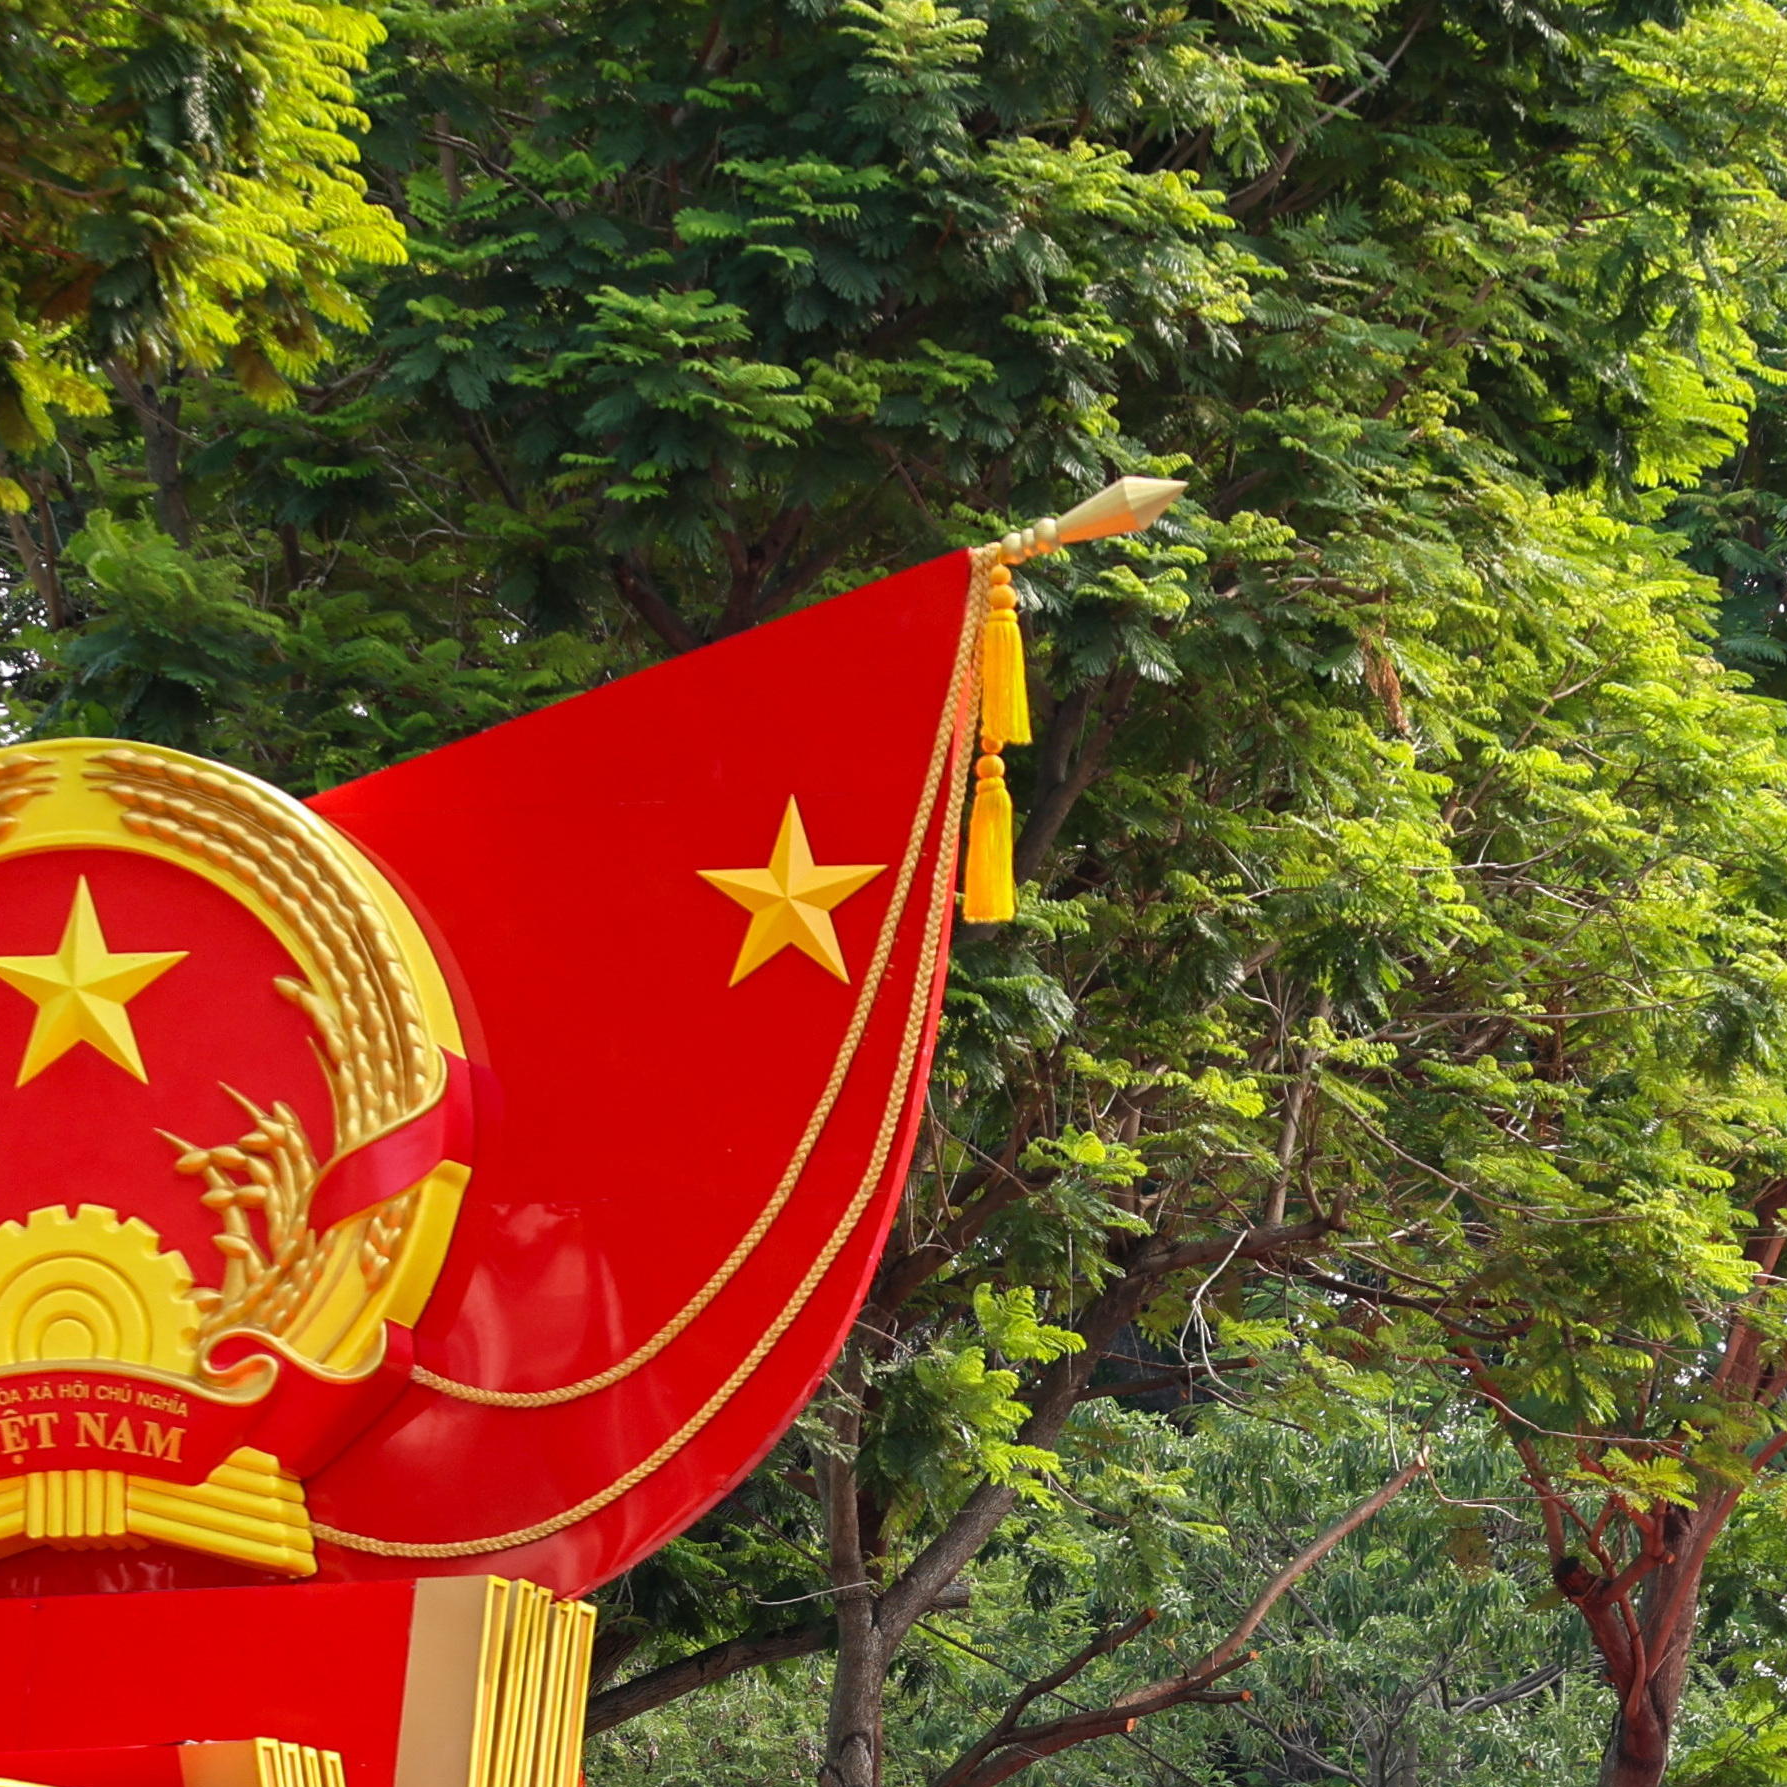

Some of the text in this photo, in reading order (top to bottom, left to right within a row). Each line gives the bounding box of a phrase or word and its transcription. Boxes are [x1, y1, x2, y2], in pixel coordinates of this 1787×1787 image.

[27, 1381, 54, 1401] XÃ
[58, 1380, 90, 1402] HỘI
[94, 1383, 132, 1403] CHỦ
[136, 1393, 189, 1418] NGHĨA
[73, 1411, 187, 1463] NAM
